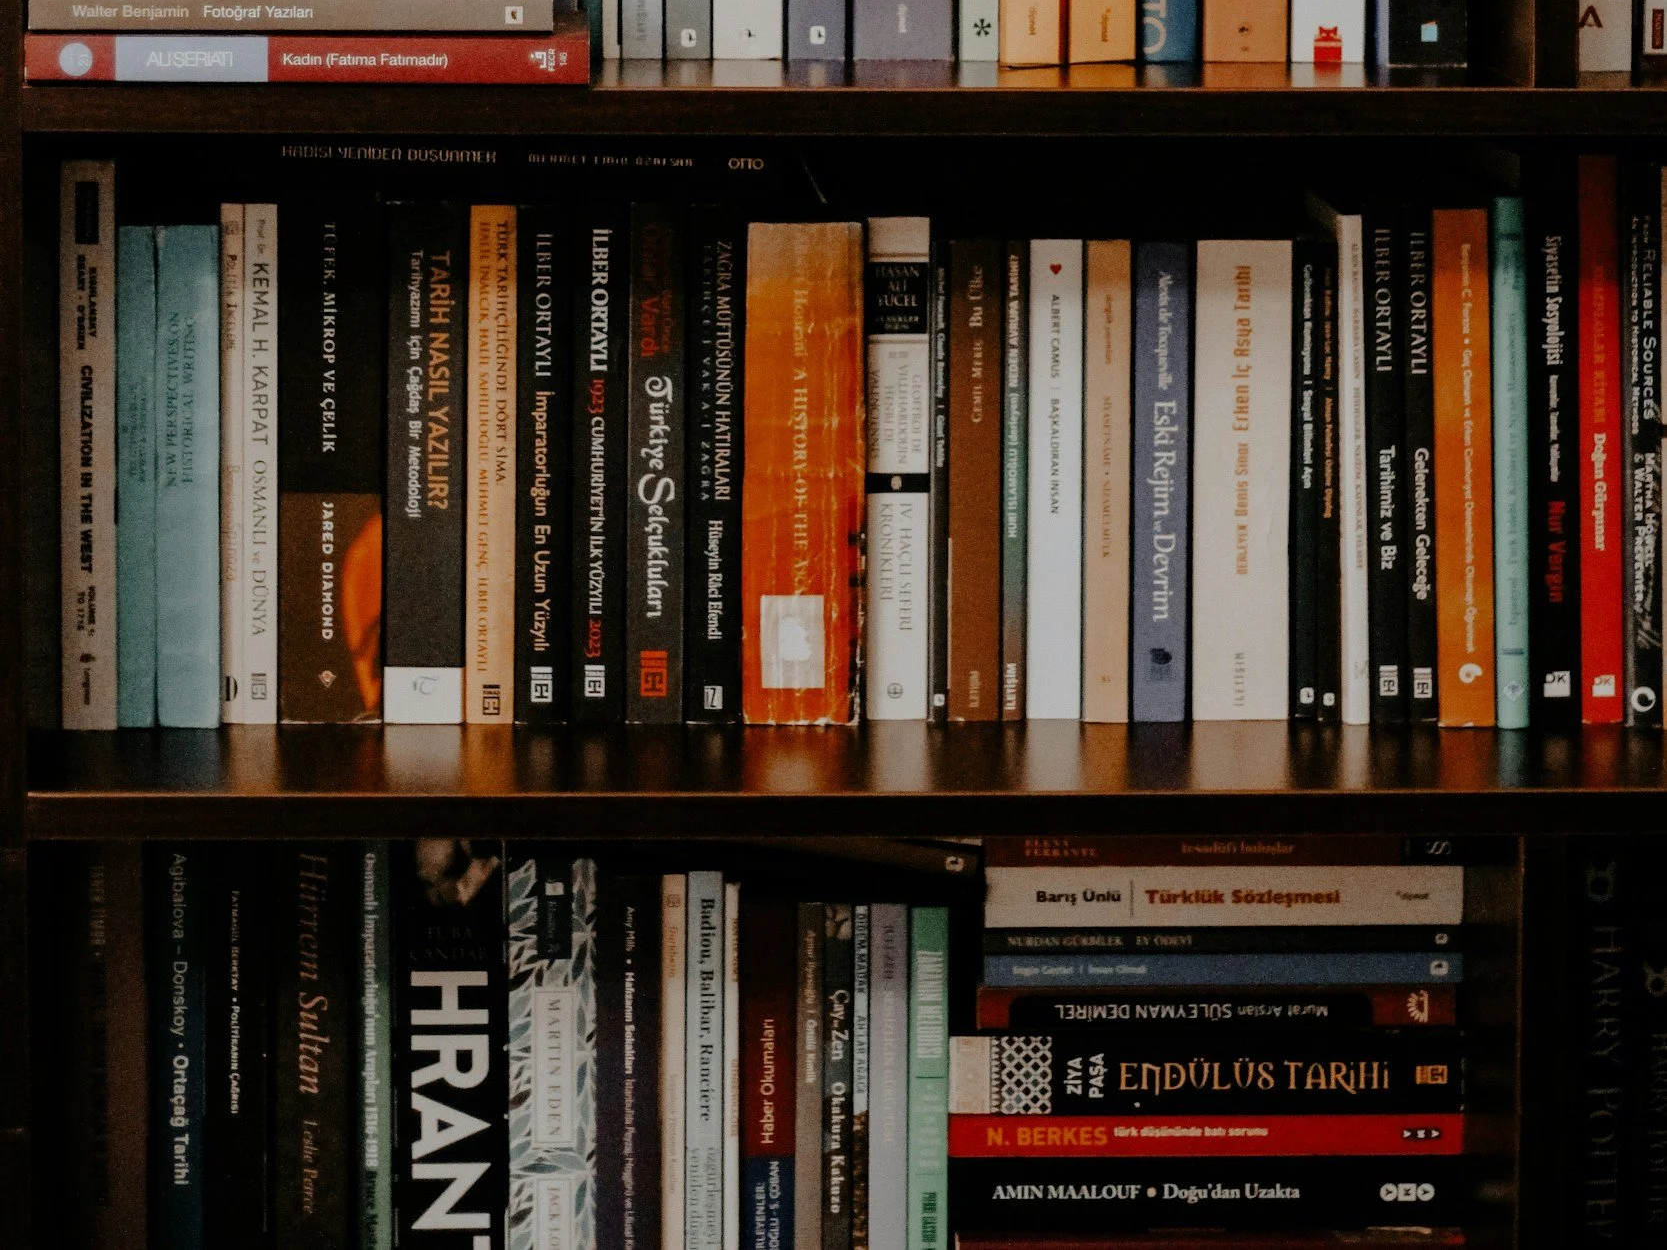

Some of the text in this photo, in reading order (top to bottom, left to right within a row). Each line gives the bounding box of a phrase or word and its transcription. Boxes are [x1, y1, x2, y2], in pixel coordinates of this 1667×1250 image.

[72, 5, 313, 21] Walter Benjamin Fotoğraf Yazıları
[283, 53, 448, 68] Kadın (Fatıma Fatımadır)
[590, 229, 612, 371] İLBER ORTAYLI
[252, 263, 269, 445] KEMAL H. KARPAT
[320, 292, 337, 452] MİKROP VE ÇELİK
[427, 251, 455, 509] TARİH NASIL YAZILIR?
[715, 296, 733, 500] MÜFTÜSÜNÜN HATIRALARI
[80, 365, 93, 573] CIVILIZATION IN THE WEST
[641, 377, 672, 470] Türkiye
[252, 460, 268, 635] OSMANLI DÜNYA
[530, 391, 555, 651] İmparatorluğun En Uzun Yüzyılı
[638, 474, 675, 617] Selçukluları
[1147, 401, 1178, 621] Eski Rejim Devrim
[1380, 445, 1397, 570] Tarihimiz ve Biz
[1412, 448, 1430, 600] Gelenekten Geleceğe
[322, 502, 334, 639] JARED DIAMOND
[699, 899, 716, 964] Badiou,
[1036, 889, 1121, 906] Barış Ünlü
[1145, 889, 1340, 908] Türklük Sözleşmesi
[170, 961, 188, 1035] Donskoy
[299, 992, 330, 1093] Sultan
[700, 970, 715, 1038] Balibar,
[170, 1055, 189, 1127] Ortaçağ
[1089, 1054, 1108, 1098] PAŞA
[1120, 1058, 1388, 1095] ENDÜLÜS TARİHİ
[174, 1133, 189, 1184] Tarihi
[828, 1082, 846, 1213] Okakura Kakuzo
[987, 1127, 1107, 1146] N. BERKES
[993, 1183, 1300, 1203] AMIN MAALOUF Doğu'dan Uzakta
